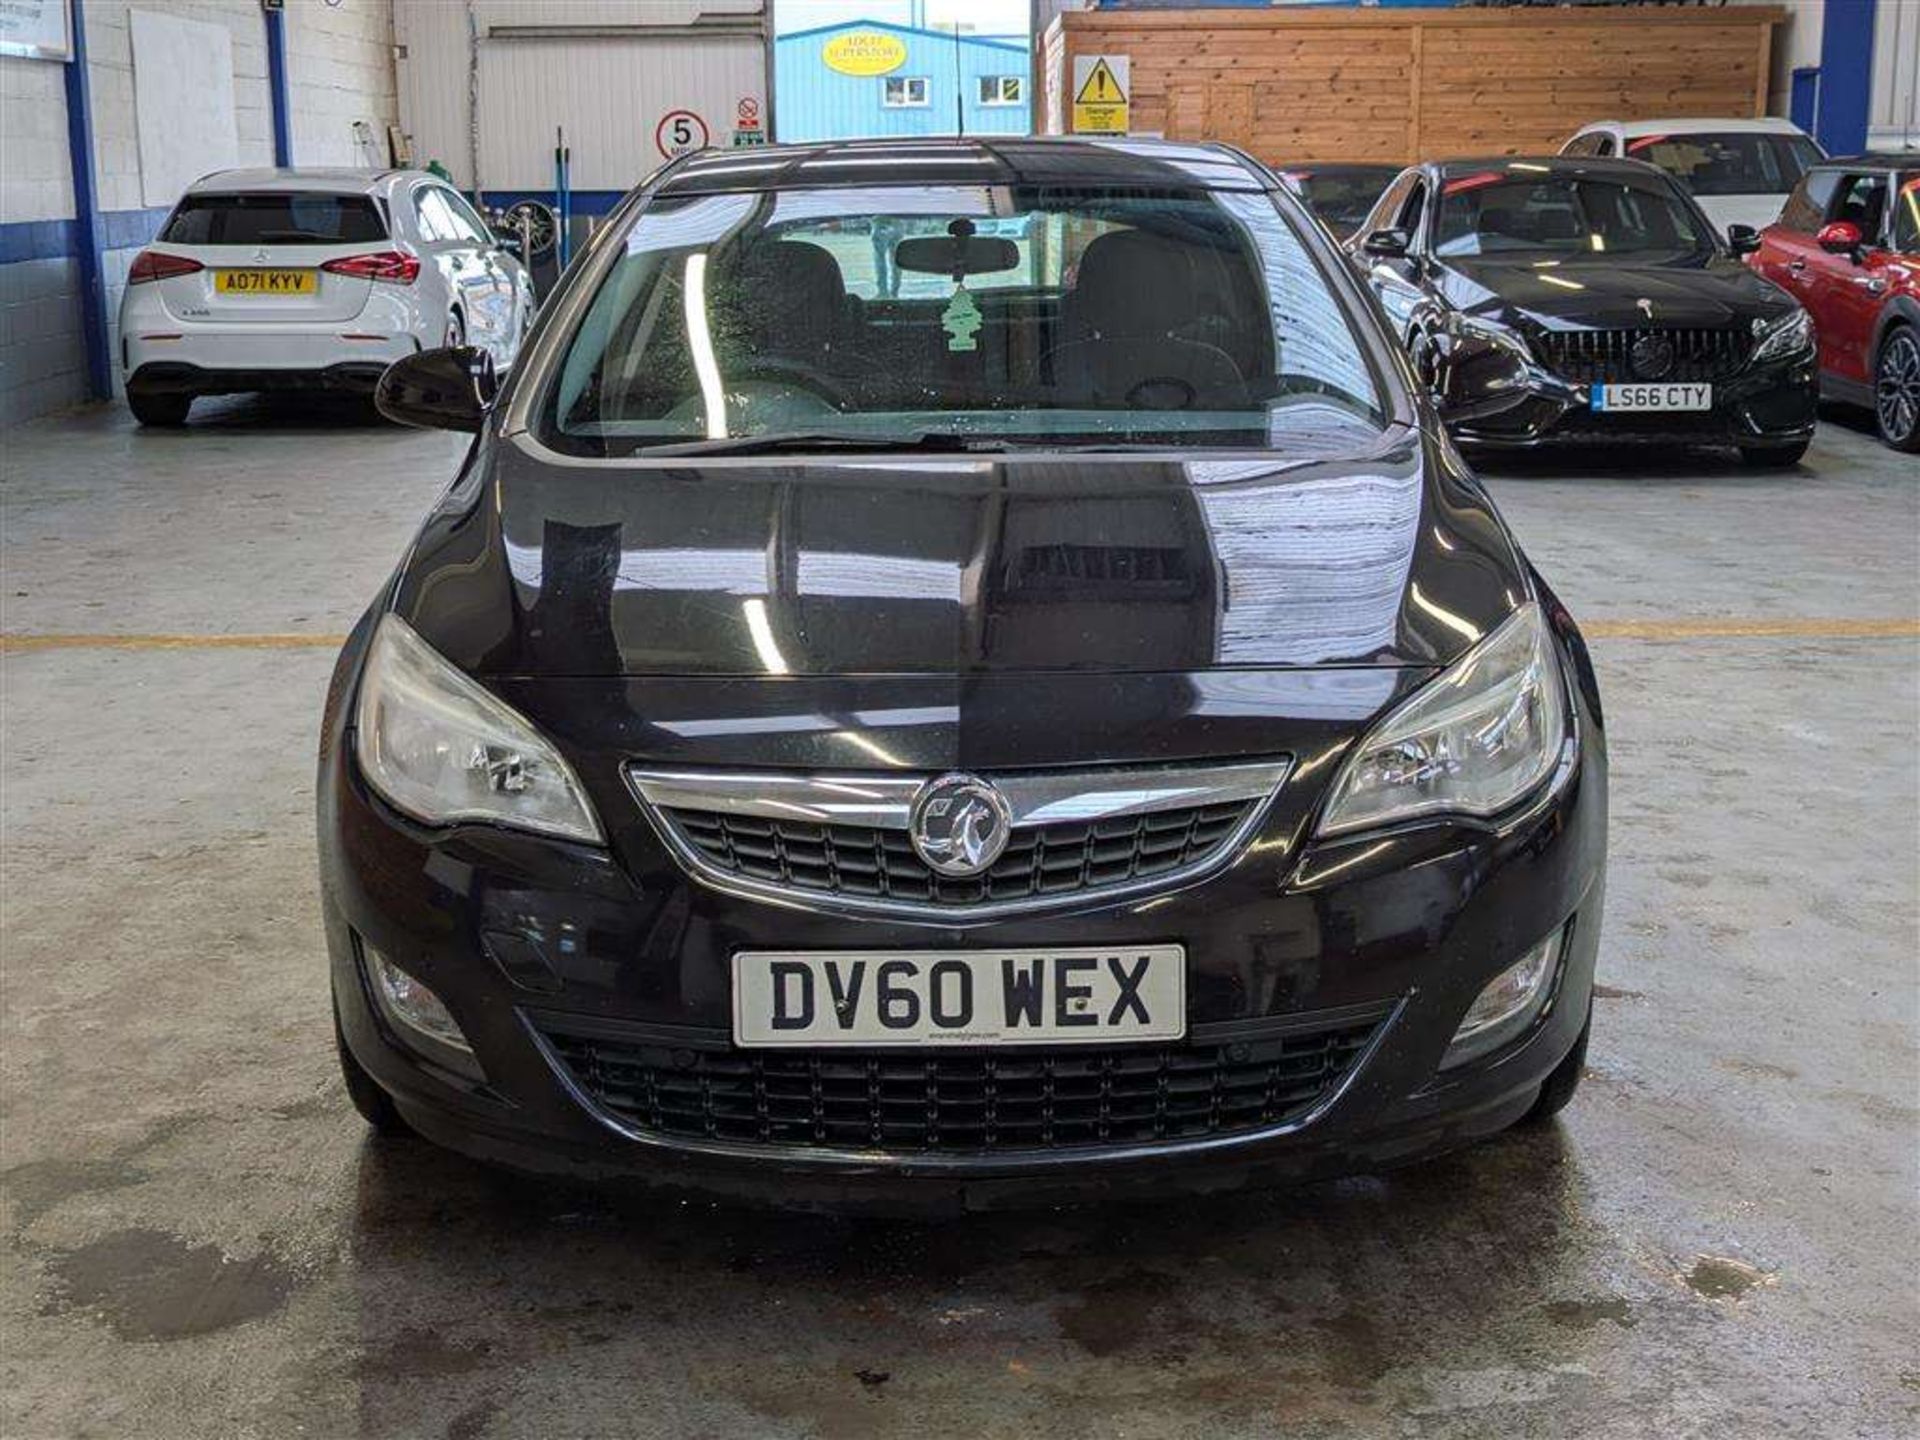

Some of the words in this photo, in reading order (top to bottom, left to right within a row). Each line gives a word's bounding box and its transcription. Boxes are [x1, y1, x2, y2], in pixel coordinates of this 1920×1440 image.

[674, 118, 691, 145] 5
[226, 273, 264, 290] AO71
[269, 273, 304, 290] KYV
[1607, 387, 1660, 407] LS66
[1667, 387, 1706, 406] CTY
[769, 959, 974, 1030] DV60
[1001, 956, 1151, 1029] WEX
